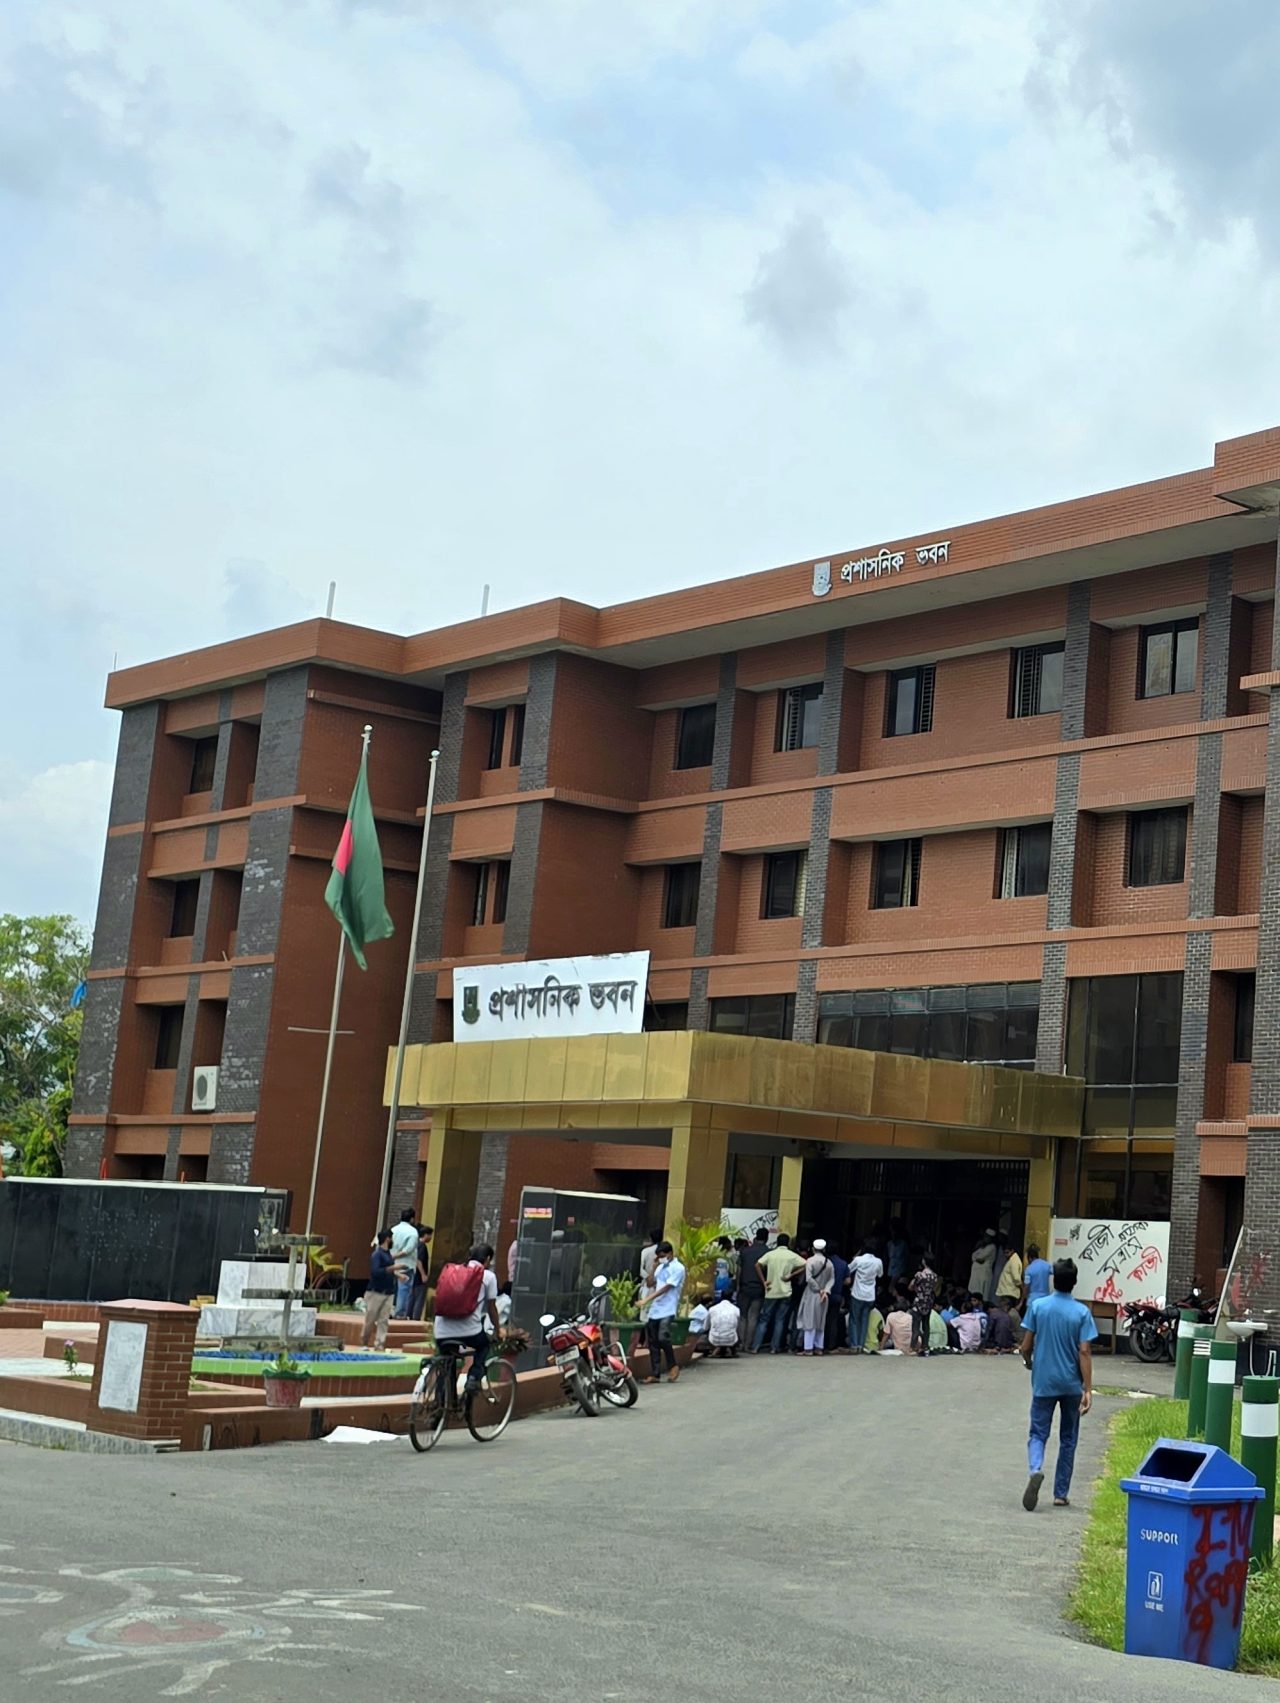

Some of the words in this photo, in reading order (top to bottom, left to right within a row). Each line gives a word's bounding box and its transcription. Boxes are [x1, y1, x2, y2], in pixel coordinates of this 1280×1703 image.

[841, 548, 905, 583] প্রশাসনিক
[915, 541, 951, 566] ভবন
[489, 975, 582, 1022] প্রশাসনিক
[588, 980, 638, 1013] ভবন
